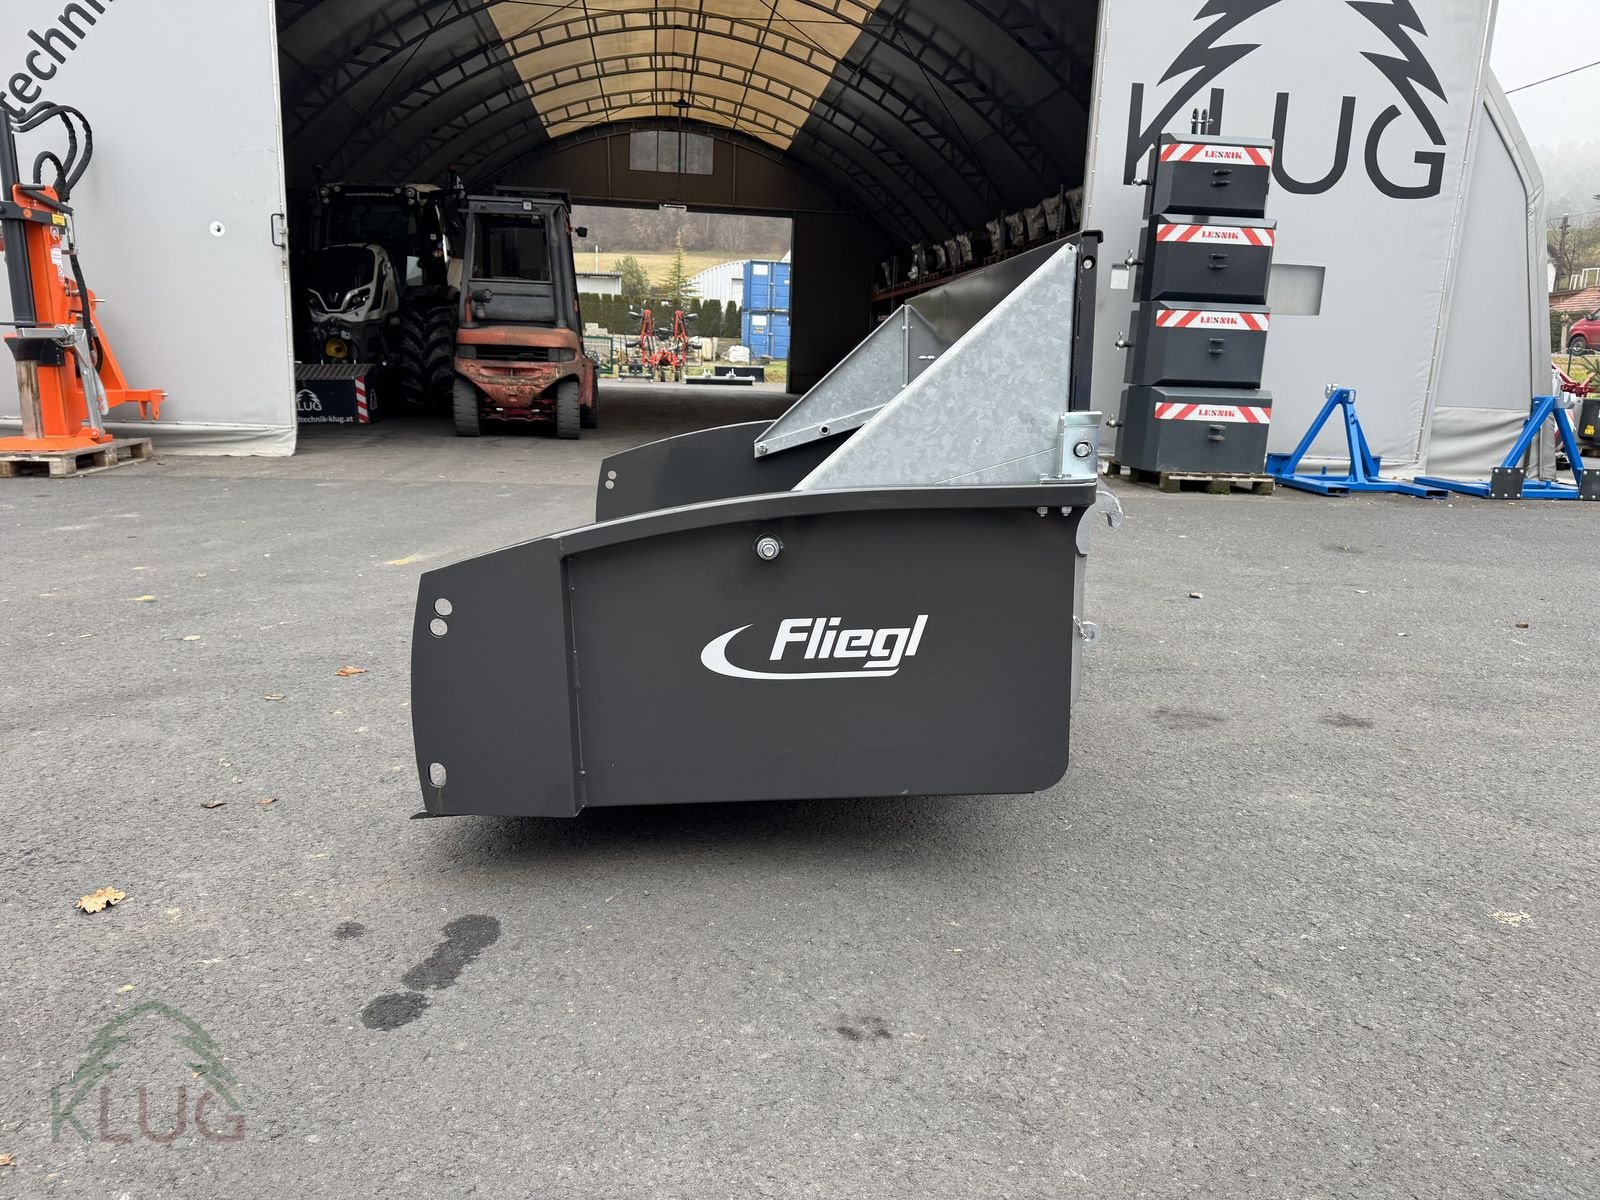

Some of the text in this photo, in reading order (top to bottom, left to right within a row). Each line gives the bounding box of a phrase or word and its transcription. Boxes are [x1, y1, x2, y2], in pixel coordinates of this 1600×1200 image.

[1204, 149, 1243, 160] LESNIK
[1201, 230, 1240, 242] LESNIK
[1200, 315, 1238, 327] LESNIK
[1197, 408, 1236, 420] LESNIK
[770, 614, 929, 668] Fliegl
